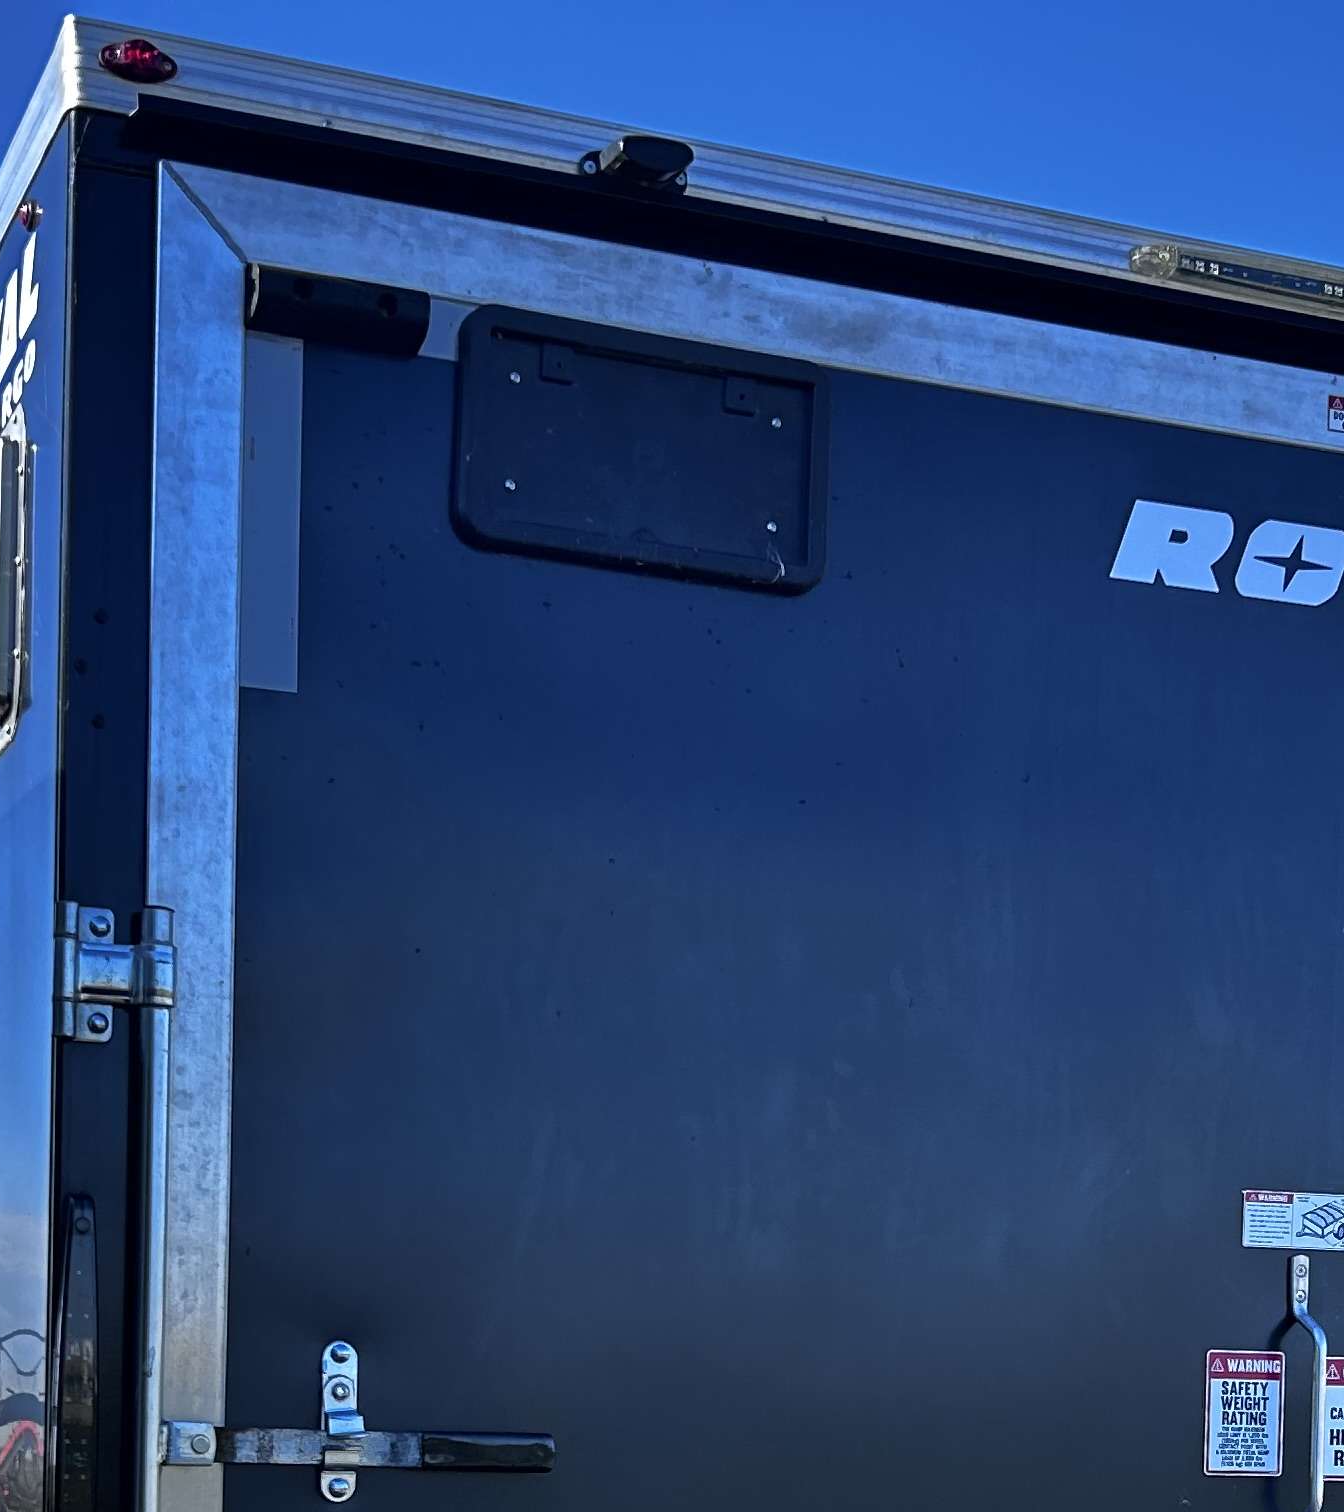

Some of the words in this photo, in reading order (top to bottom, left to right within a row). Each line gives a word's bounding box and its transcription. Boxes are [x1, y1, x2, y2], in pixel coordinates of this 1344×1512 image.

[1334, 411, 1344, 421] DO
[1227, 1359, 1281, 1374] WARNING
[1221, 1381, 1269, 1396] SAFETY
[1221, 1396, 1269, 1411] WEIGHT
[1222, 1411, 1267, 1426] RATING
